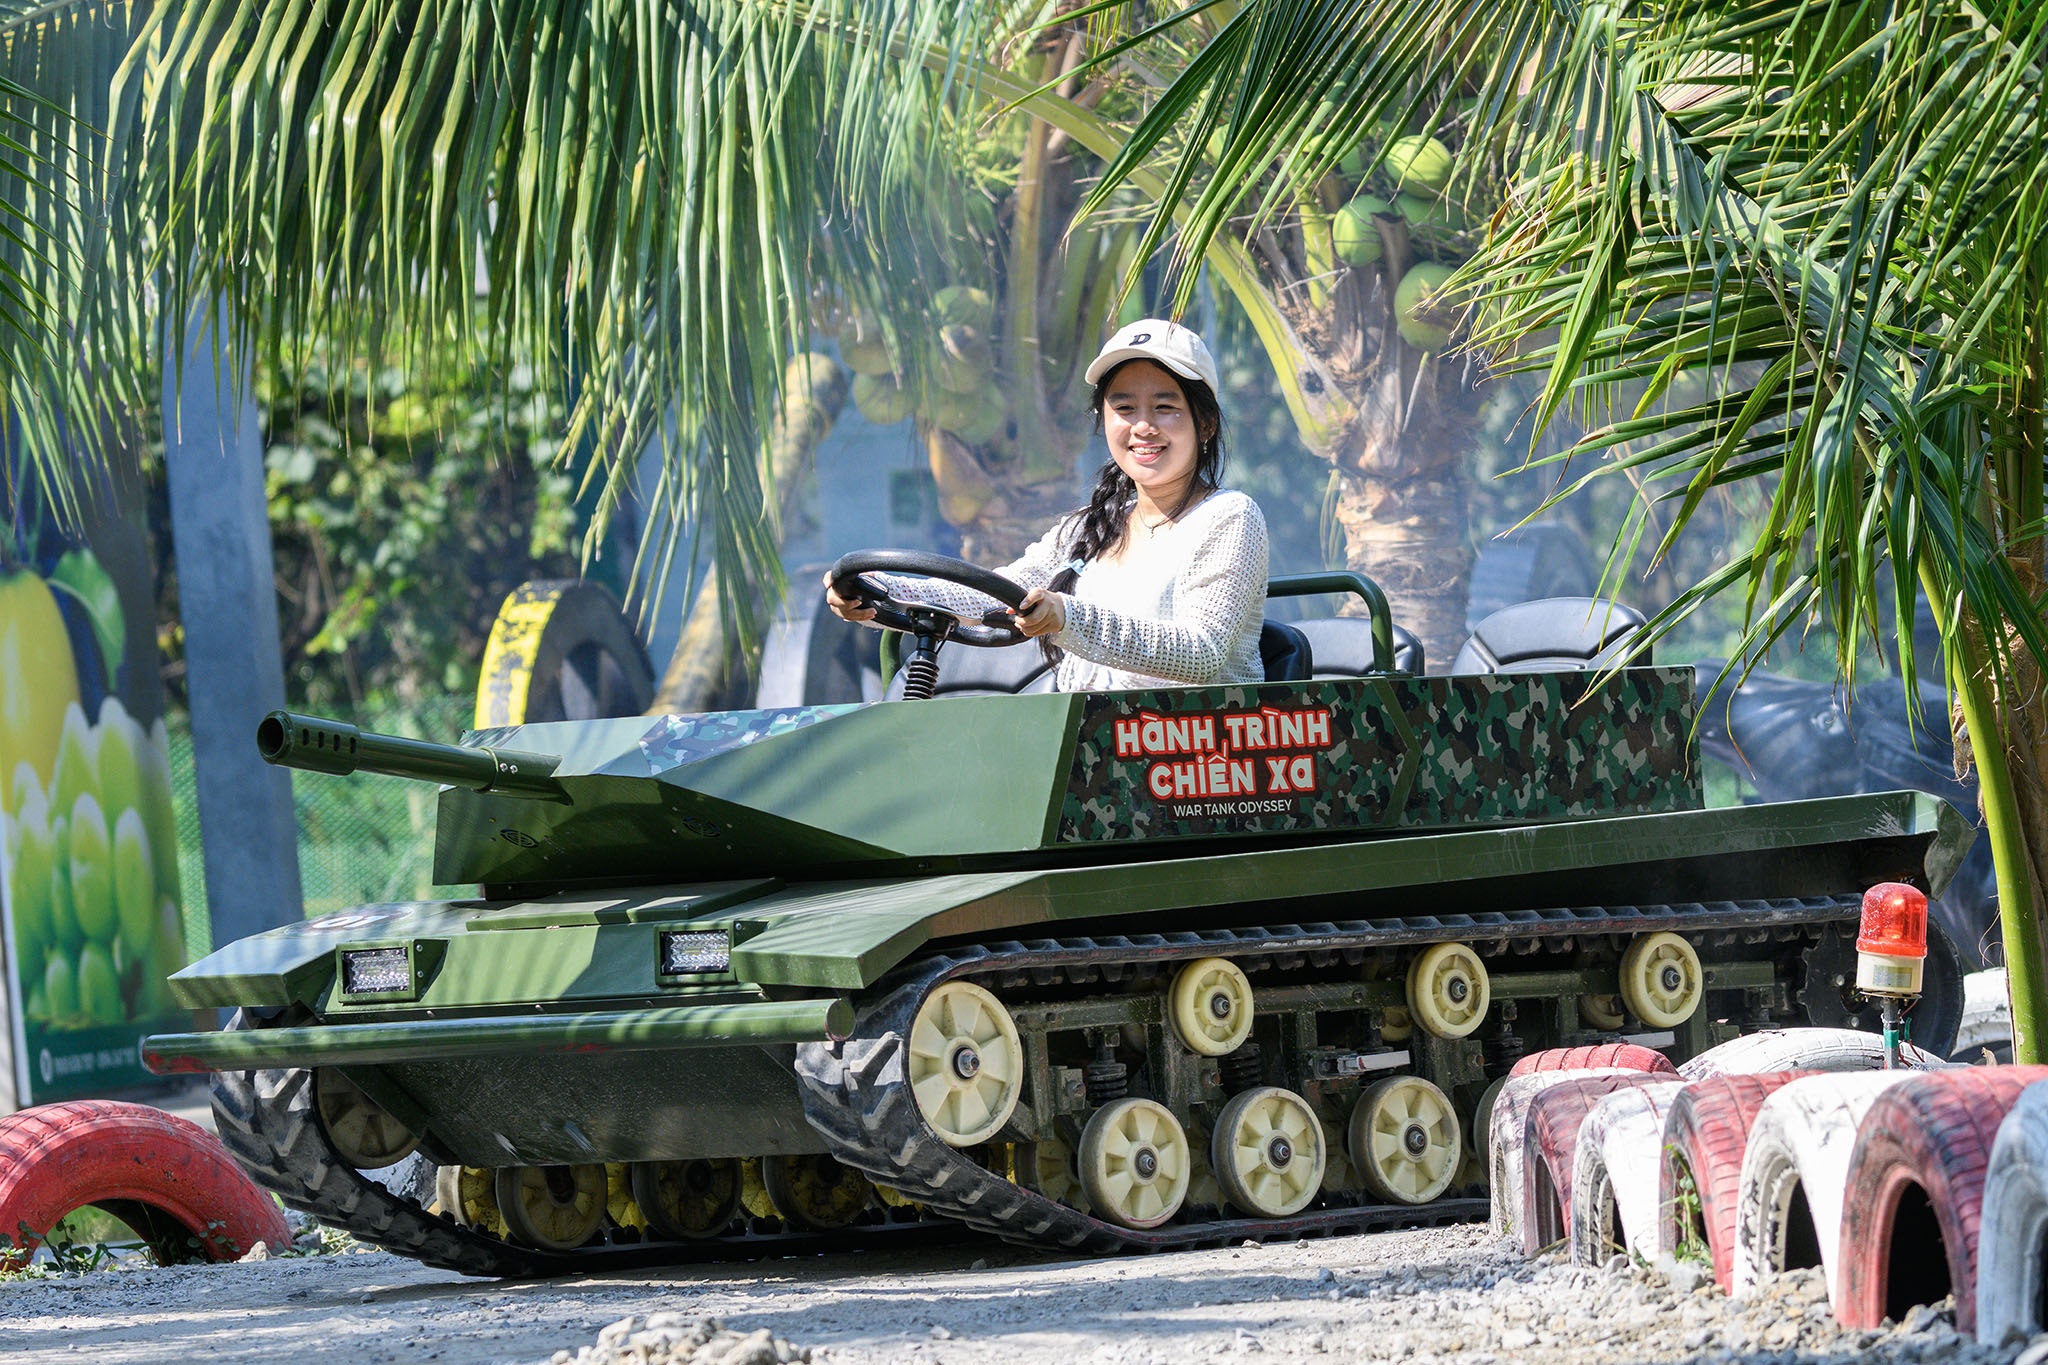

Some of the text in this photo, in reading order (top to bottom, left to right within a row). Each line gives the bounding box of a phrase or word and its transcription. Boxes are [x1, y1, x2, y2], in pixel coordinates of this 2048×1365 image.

[1128, 333, 1152, 346] D
[1225, 705, 1331, 748] TRÌNH
[1173, 799, 1293, 818] WAR TANK ODYSSEY
